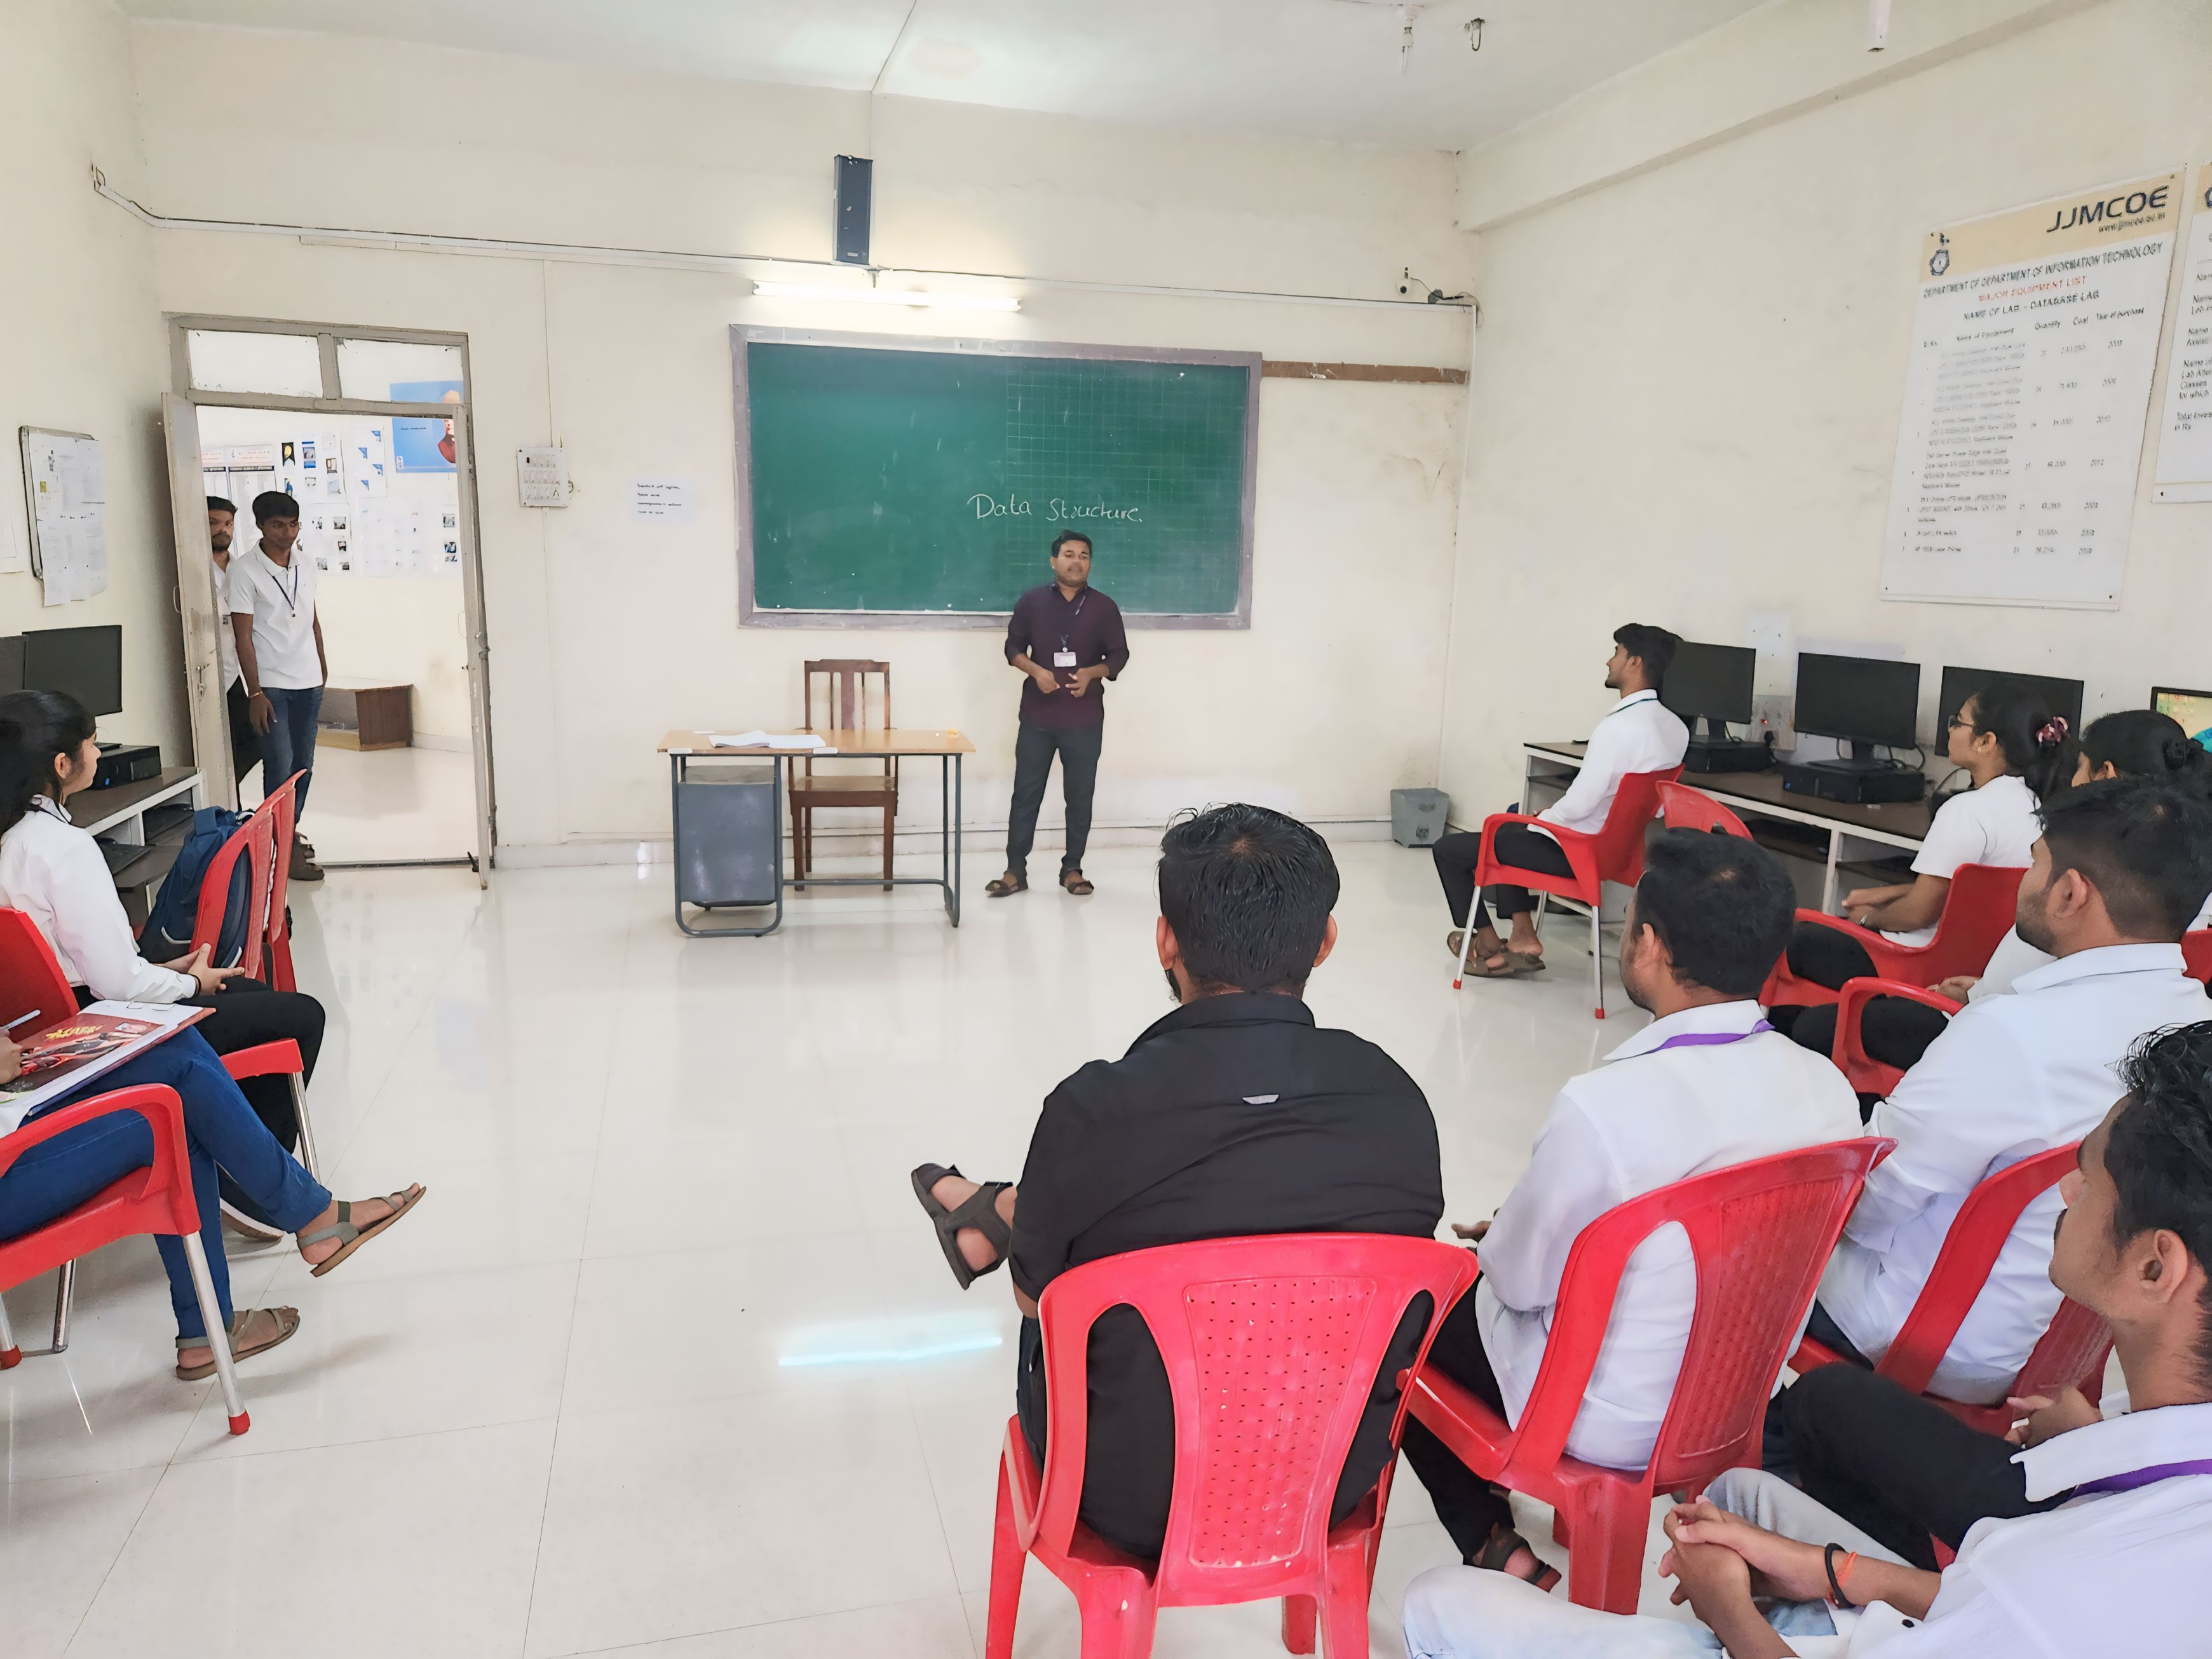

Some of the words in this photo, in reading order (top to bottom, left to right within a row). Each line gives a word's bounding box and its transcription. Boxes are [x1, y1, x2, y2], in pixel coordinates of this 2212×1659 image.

[2047, 185, 2169, 233] JJMCOE
[1981, 268, 2030, 287] DEPARTMENT
[2046, 254, 2100, 274] INFORMATION
[2102, 241, 2163, 264] TECHNOLOGY
[2031, 293, 2078, 309] DATABASE
[967, 494, 1032, 520] Data
